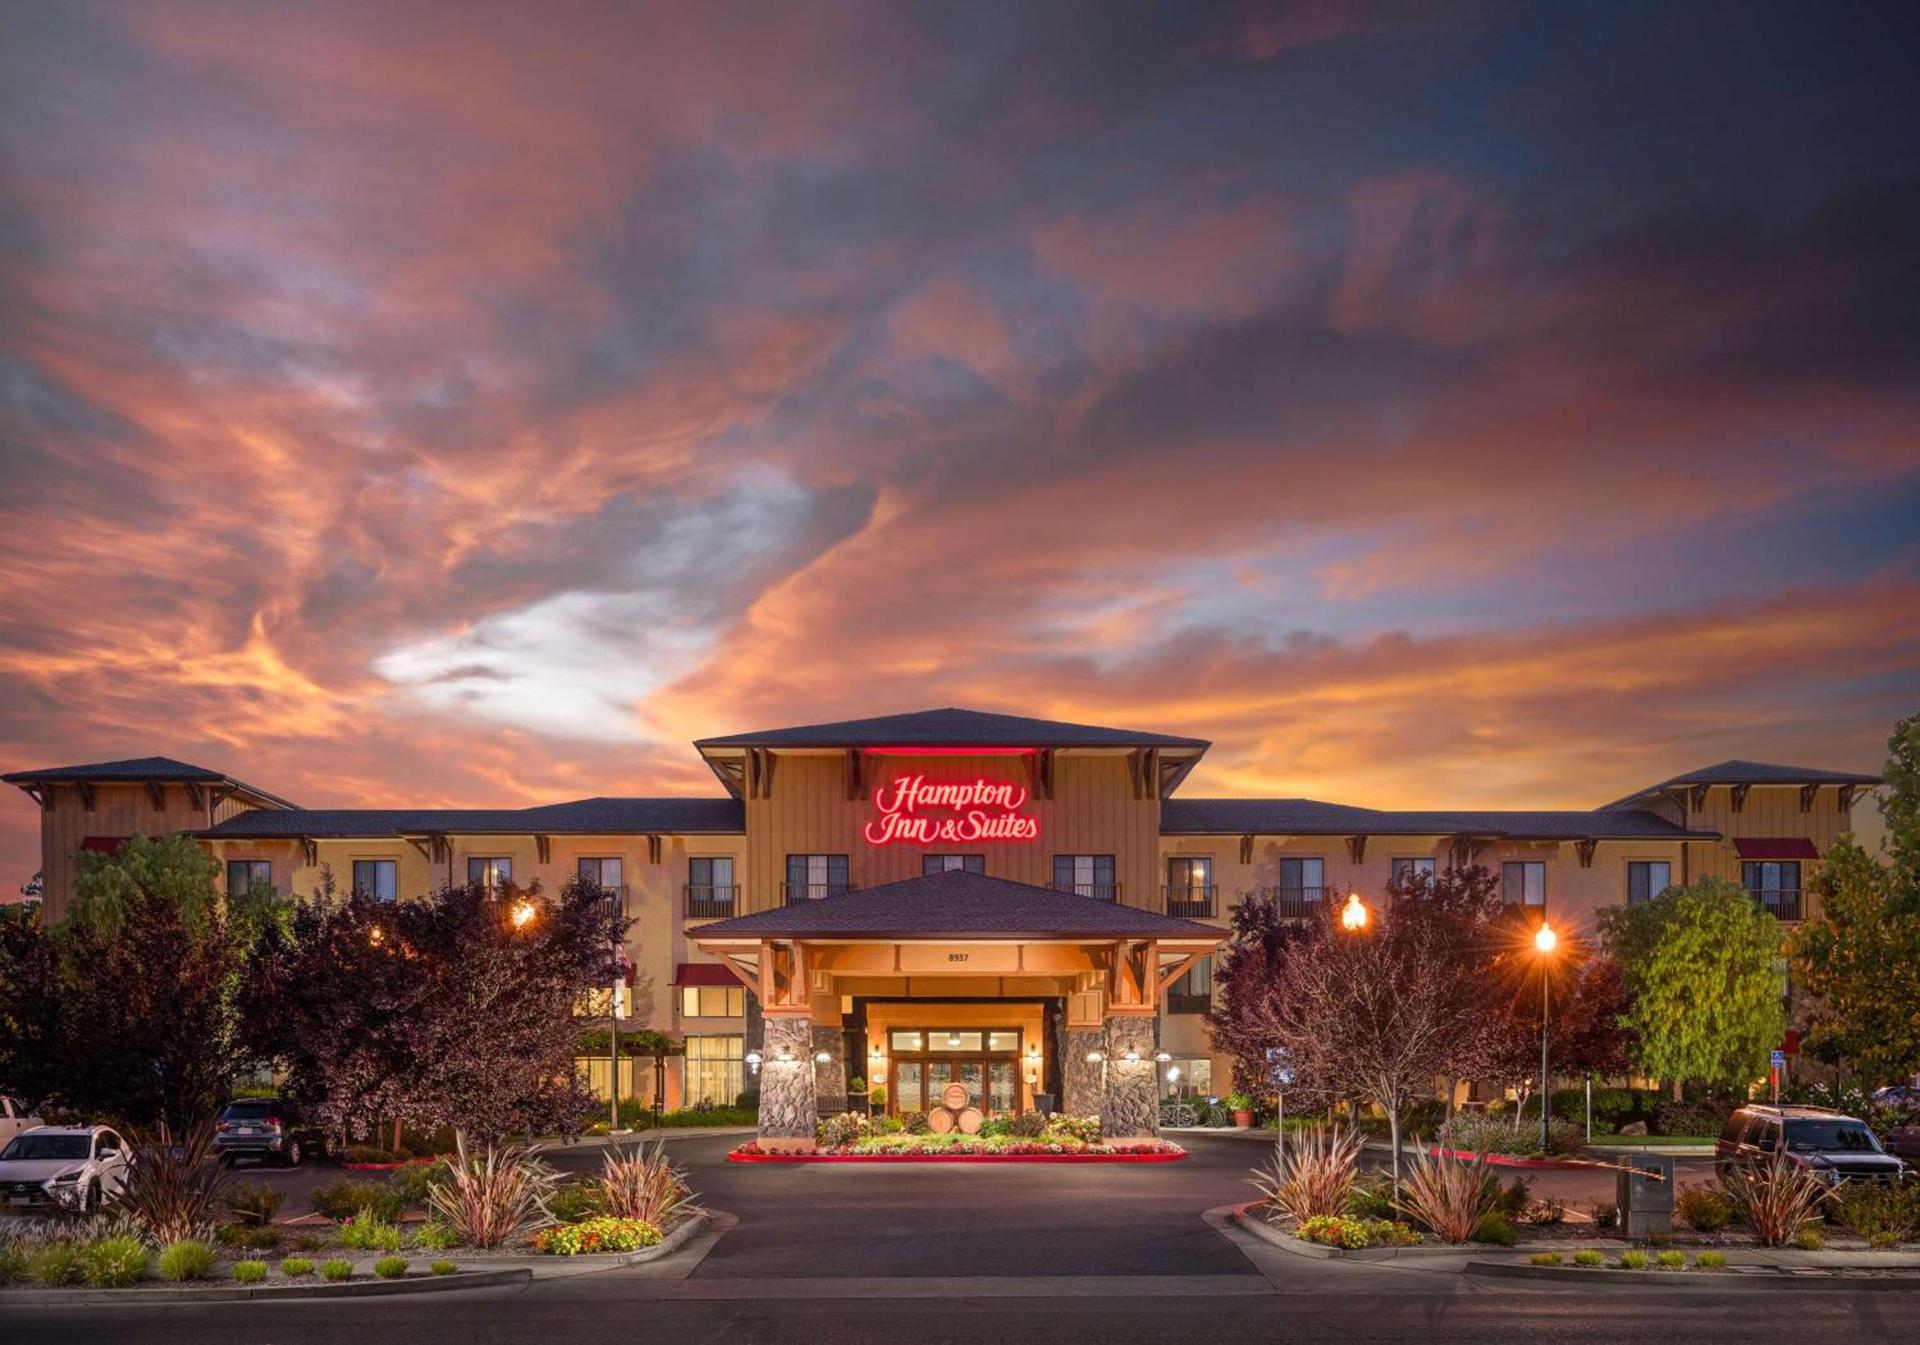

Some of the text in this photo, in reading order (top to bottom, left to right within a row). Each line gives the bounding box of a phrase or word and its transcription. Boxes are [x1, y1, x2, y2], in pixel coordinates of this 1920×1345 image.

[876, 775, 1025, 813] Hampton
[865, 811, 1037, 844] Inn & Suites
[949, 953, 969, 962] 8937
